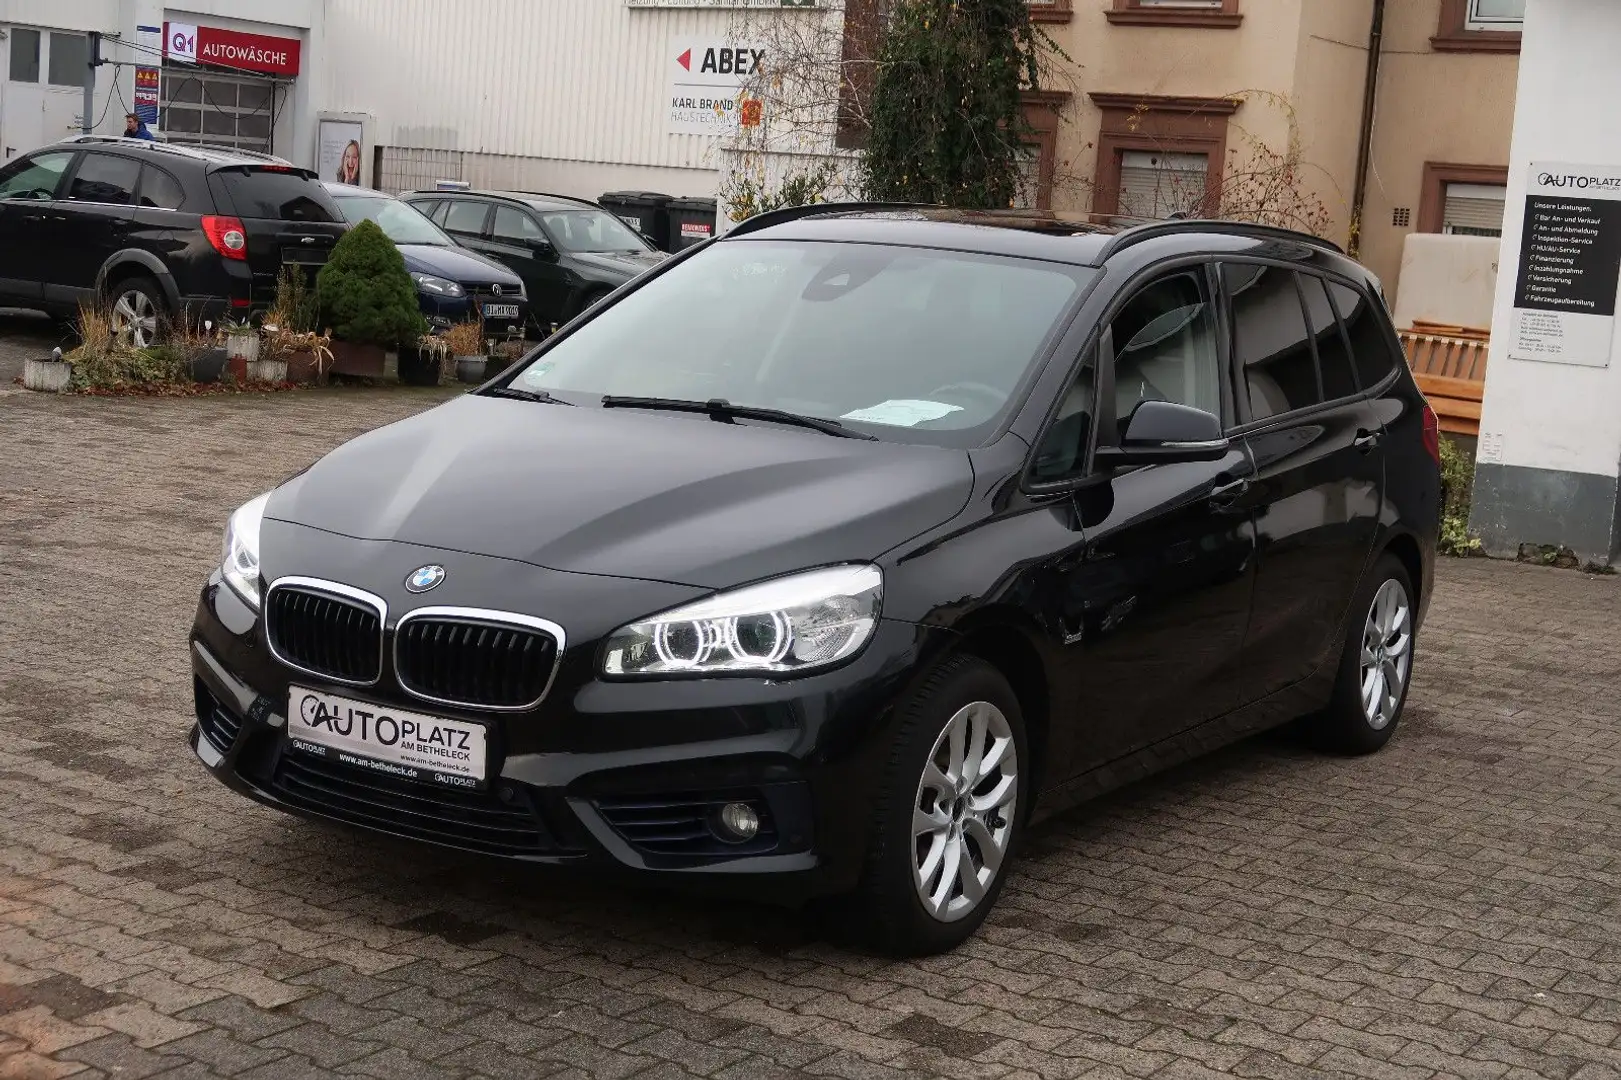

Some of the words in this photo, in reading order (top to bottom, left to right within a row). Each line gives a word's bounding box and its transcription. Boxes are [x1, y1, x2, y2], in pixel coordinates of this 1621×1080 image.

[172, 32, 194, 53] Q1
[202, 42, 287, 66] AUTOWÄSCHE
[700, 47, 766, 75] ABEX
[672, 97, 697, 109] KARL
[700, 98, 733, 110] BRAND
[1540, 173, 1621, 189] AUTOPLATZ
[1534, 202, 1556, 210] Unsere
[1577, 217, 1601, 225] Verkauf
[1564, 226, 1598, 236] Abmeldung
[1537, 234, 1593, 245] Inspektion-Service
[1535, 255, 1574, 265] Finanzierung
[1532, 275, 1572, 285] Versicherung
[1531, 284, 1557, 293] Garantie
[307, 699, 471, 750] AUTOPLATZ
[400, 740, 415, 751] AM
[416, 743, 471, 762] BETHELECK
[339, 753, 418, 779] www.am-betheleck.de
[400, 754, 471, 773] www.am-betheleck.de
